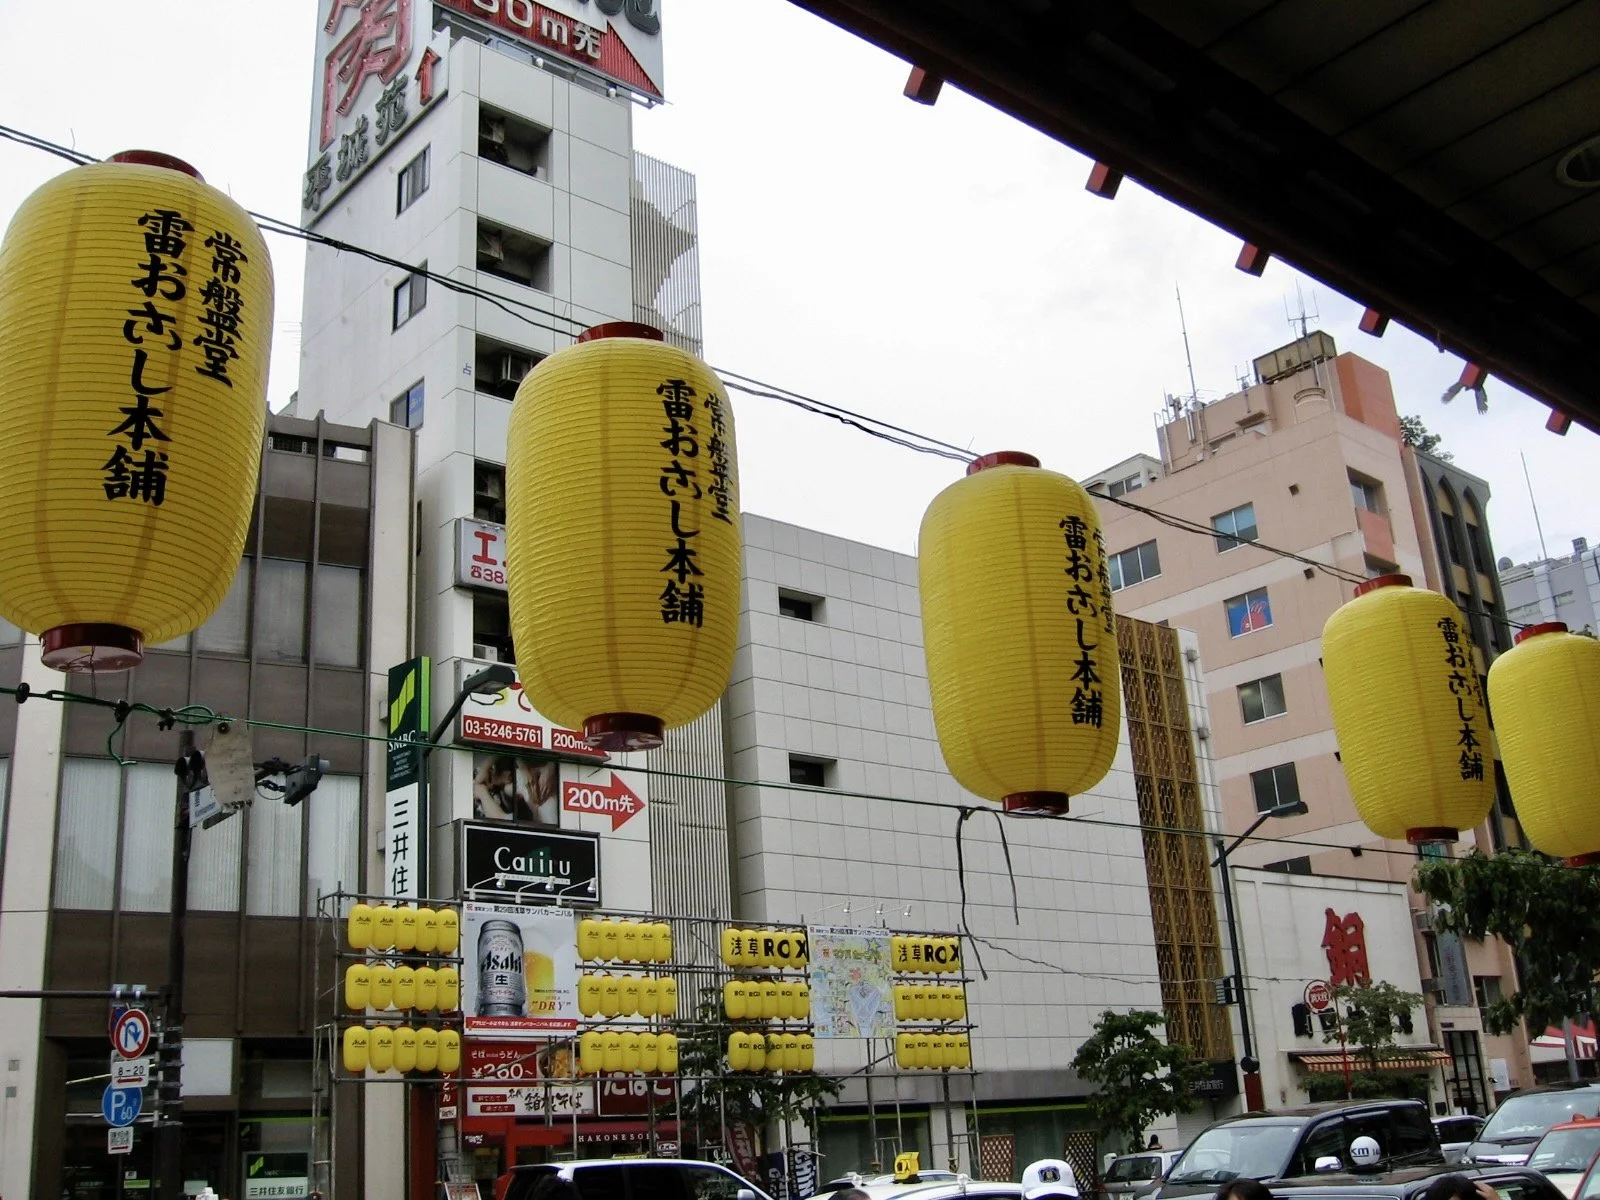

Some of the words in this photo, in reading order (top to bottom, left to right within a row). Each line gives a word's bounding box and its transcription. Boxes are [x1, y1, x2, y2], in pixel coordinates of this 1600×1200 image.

[192, 231, 248, 388] 常盤堂
[388, 730, 416, 752] SMBC
[465, 719, 542, 744] 03-5246-5761
[567, 787, 635, 814] 200m先
[481, 950, 522, 974] Asahi
[495, 974, 509, 985] 生
[111, 1091, 126, 1121] P
[121, 1106, 133, 1120] 60
